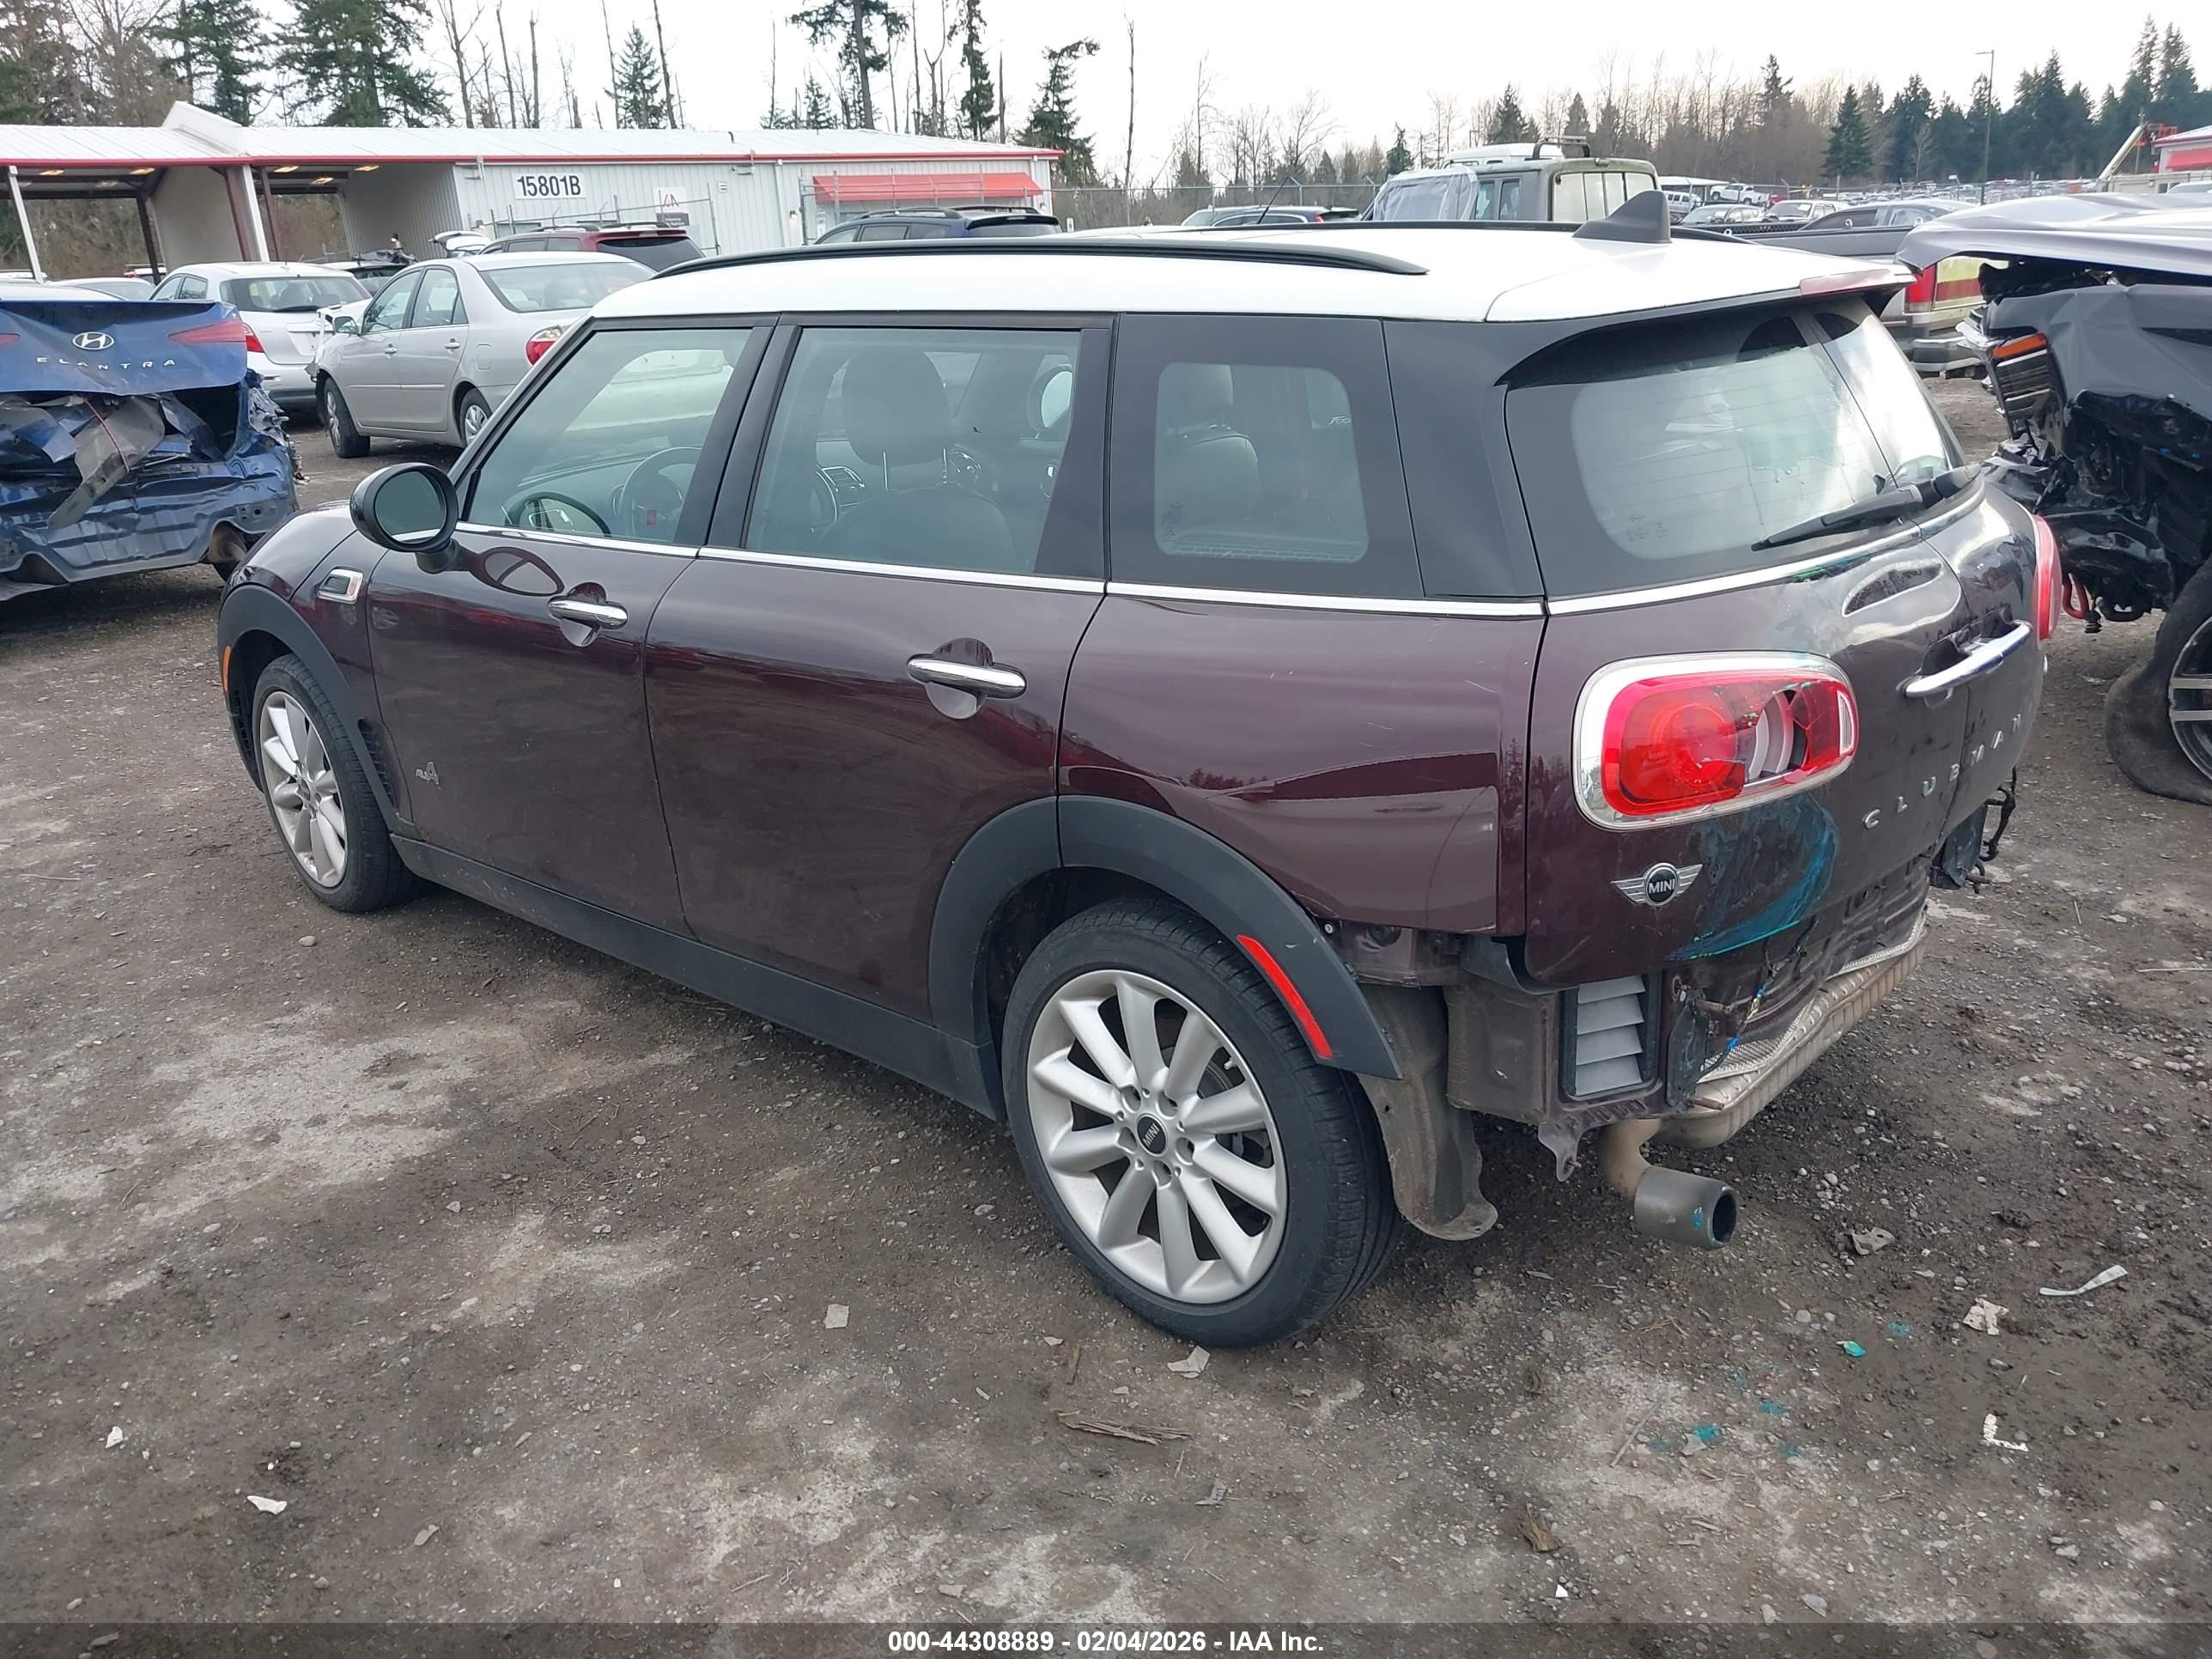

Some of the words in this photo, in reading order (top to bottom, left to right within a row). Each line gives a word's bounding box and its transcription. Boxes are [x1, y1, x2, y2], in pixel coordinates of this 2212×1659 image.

[517, 175, 581, 197] 15801B
[36, 357, 175, 370] ELANTRA
[1862, 714, 2021, 830] CLUBMAN
[1648, 878, 1676, 894] MINI
[1142, 1122, 1160, 1148] MINI
